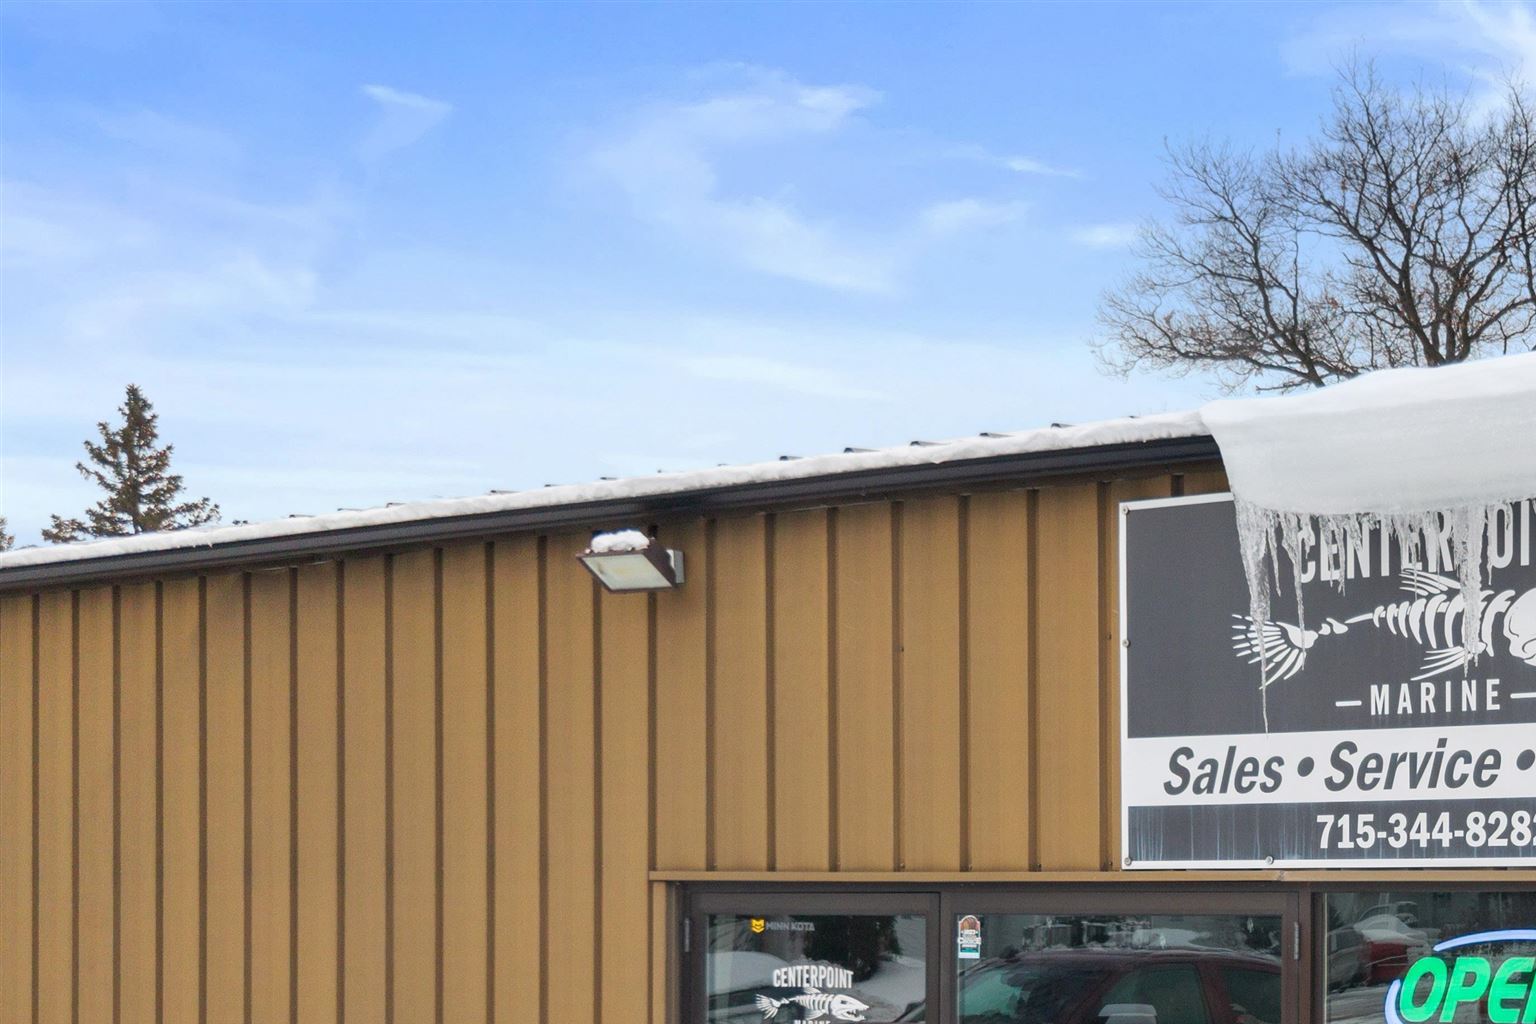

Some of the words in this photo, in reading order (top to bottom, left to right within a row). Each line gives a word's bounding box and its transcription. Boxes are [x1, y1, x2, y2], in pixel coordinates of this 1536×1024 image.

[1370, 678, 1500, 716] MARINE
[1163, 746, 1285, 796] Sales
[1323, 737, 1501, 792] Service
[766, 921, 789, 932] MINN
[791, 921, 815, 932] KOTA
[773, 965, 854, 989] CENTERPOINT
